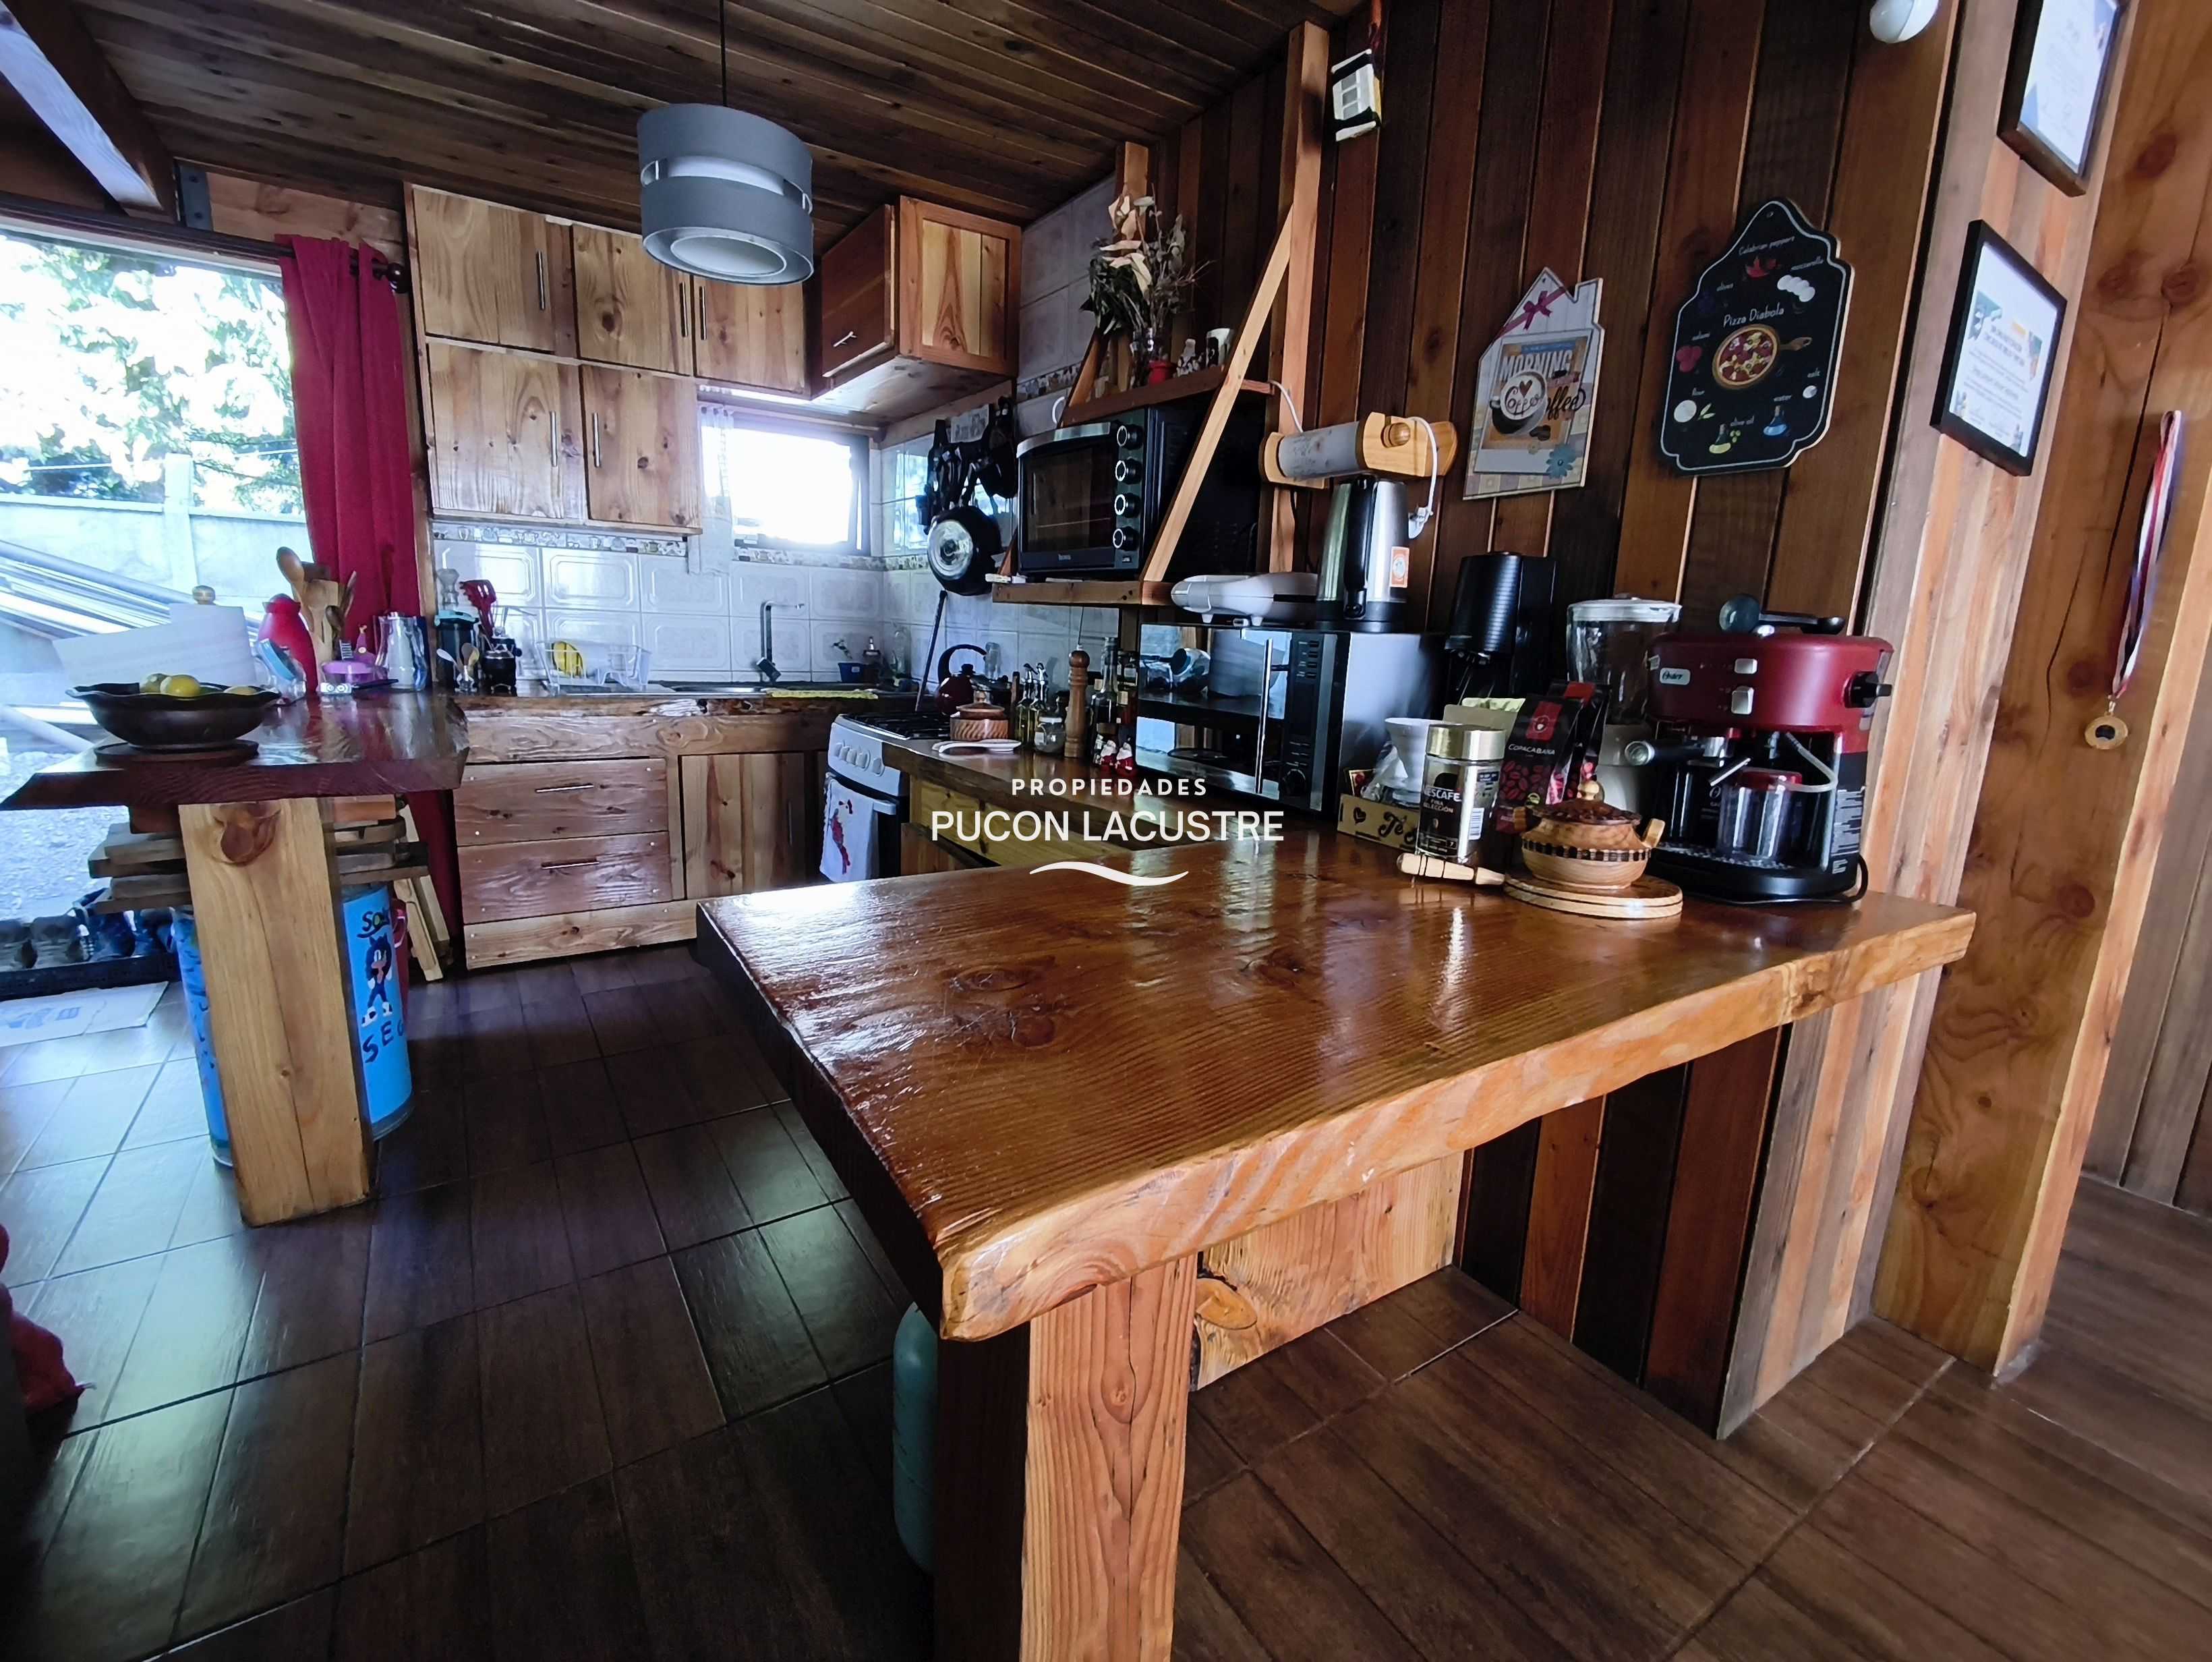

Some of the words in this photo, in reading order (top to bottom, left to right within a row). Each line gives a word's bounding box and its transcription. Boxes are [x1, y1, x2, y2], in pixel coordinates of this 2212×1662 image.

[1723, 314, 1747, 328] Pizza
[1749, 302, 1785, 322] Diabola
[1500, 349, 1573, 381] MORNING
[1508, 743, 1556, 755] COPACABANA
